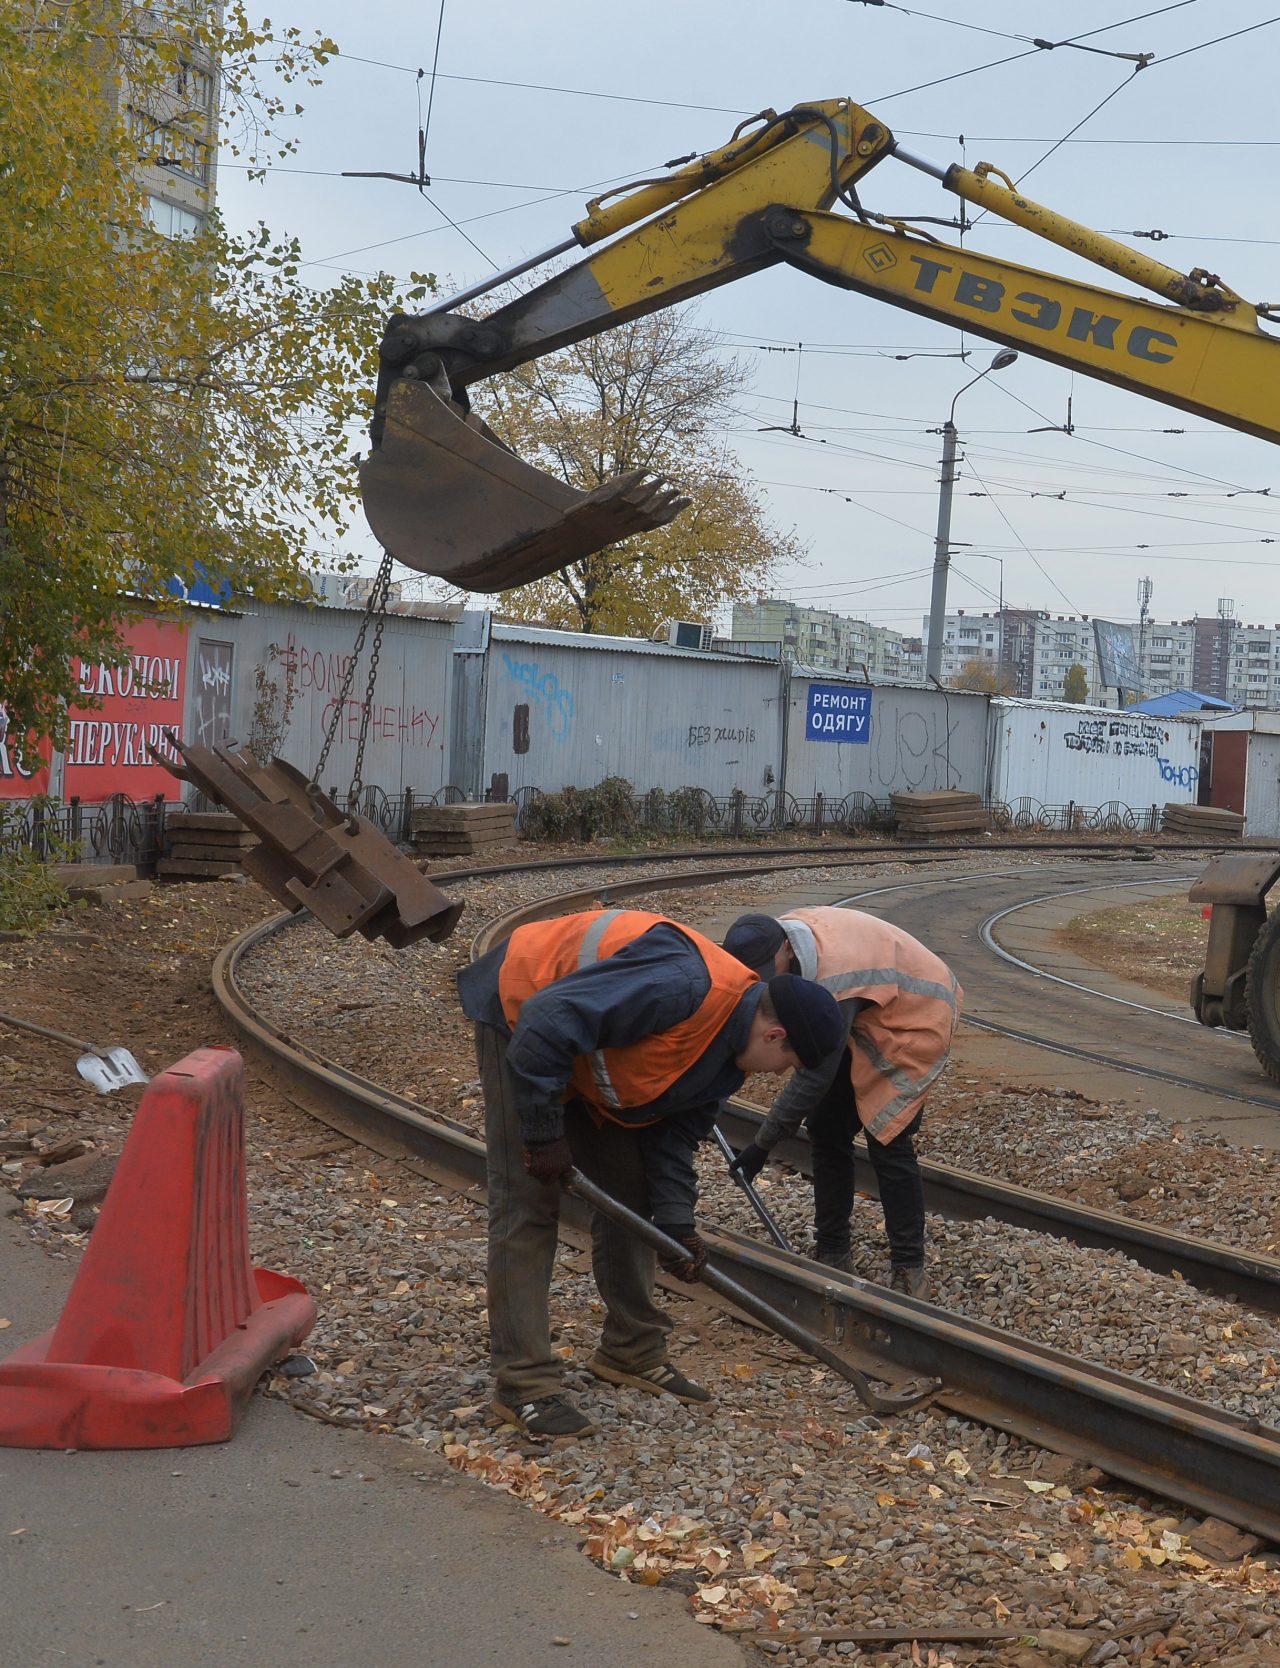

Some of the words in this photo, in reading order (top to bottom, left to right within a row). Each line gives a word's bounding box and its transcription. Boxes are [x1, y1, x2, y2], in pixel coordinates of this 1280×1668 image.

[910, 253, 1178, 364] ТВЭКС
[80, 655, 180, 700] ЕКОНОМ
[813, 693, 867, 711] РЕМОНТ
[812, 713, 865, 733] ОДЯГУ
